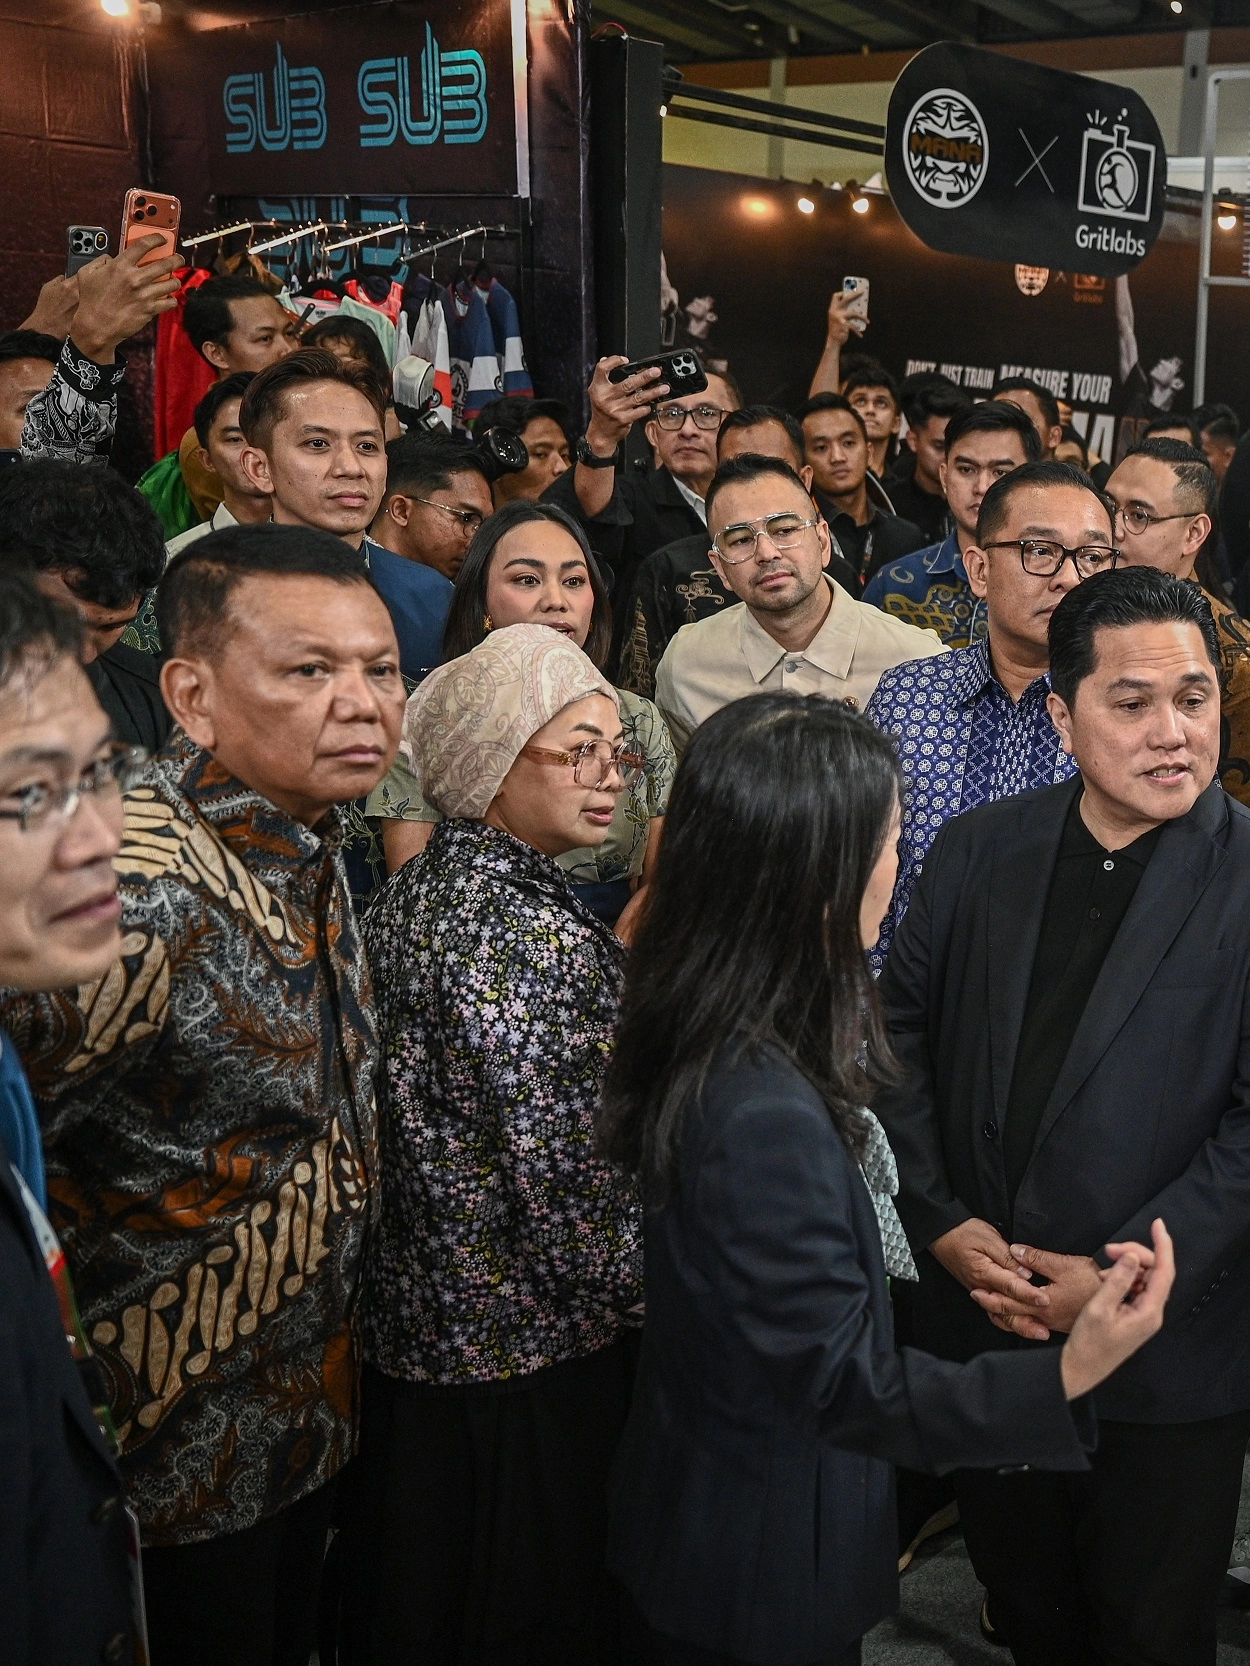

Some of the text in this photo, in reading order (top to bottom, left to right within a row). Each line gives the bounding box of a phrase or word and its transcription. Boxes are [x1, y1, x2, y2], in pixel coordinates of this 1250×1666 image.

[222, 20, 489, 153] SUB SUB
[911, 132, 983, 165] MANA
[1075, 224, 1146, 257] Gritlabs
[964, 366, 995, 390] TRAIN
[1072, 372, 1113, 404] YOUR
